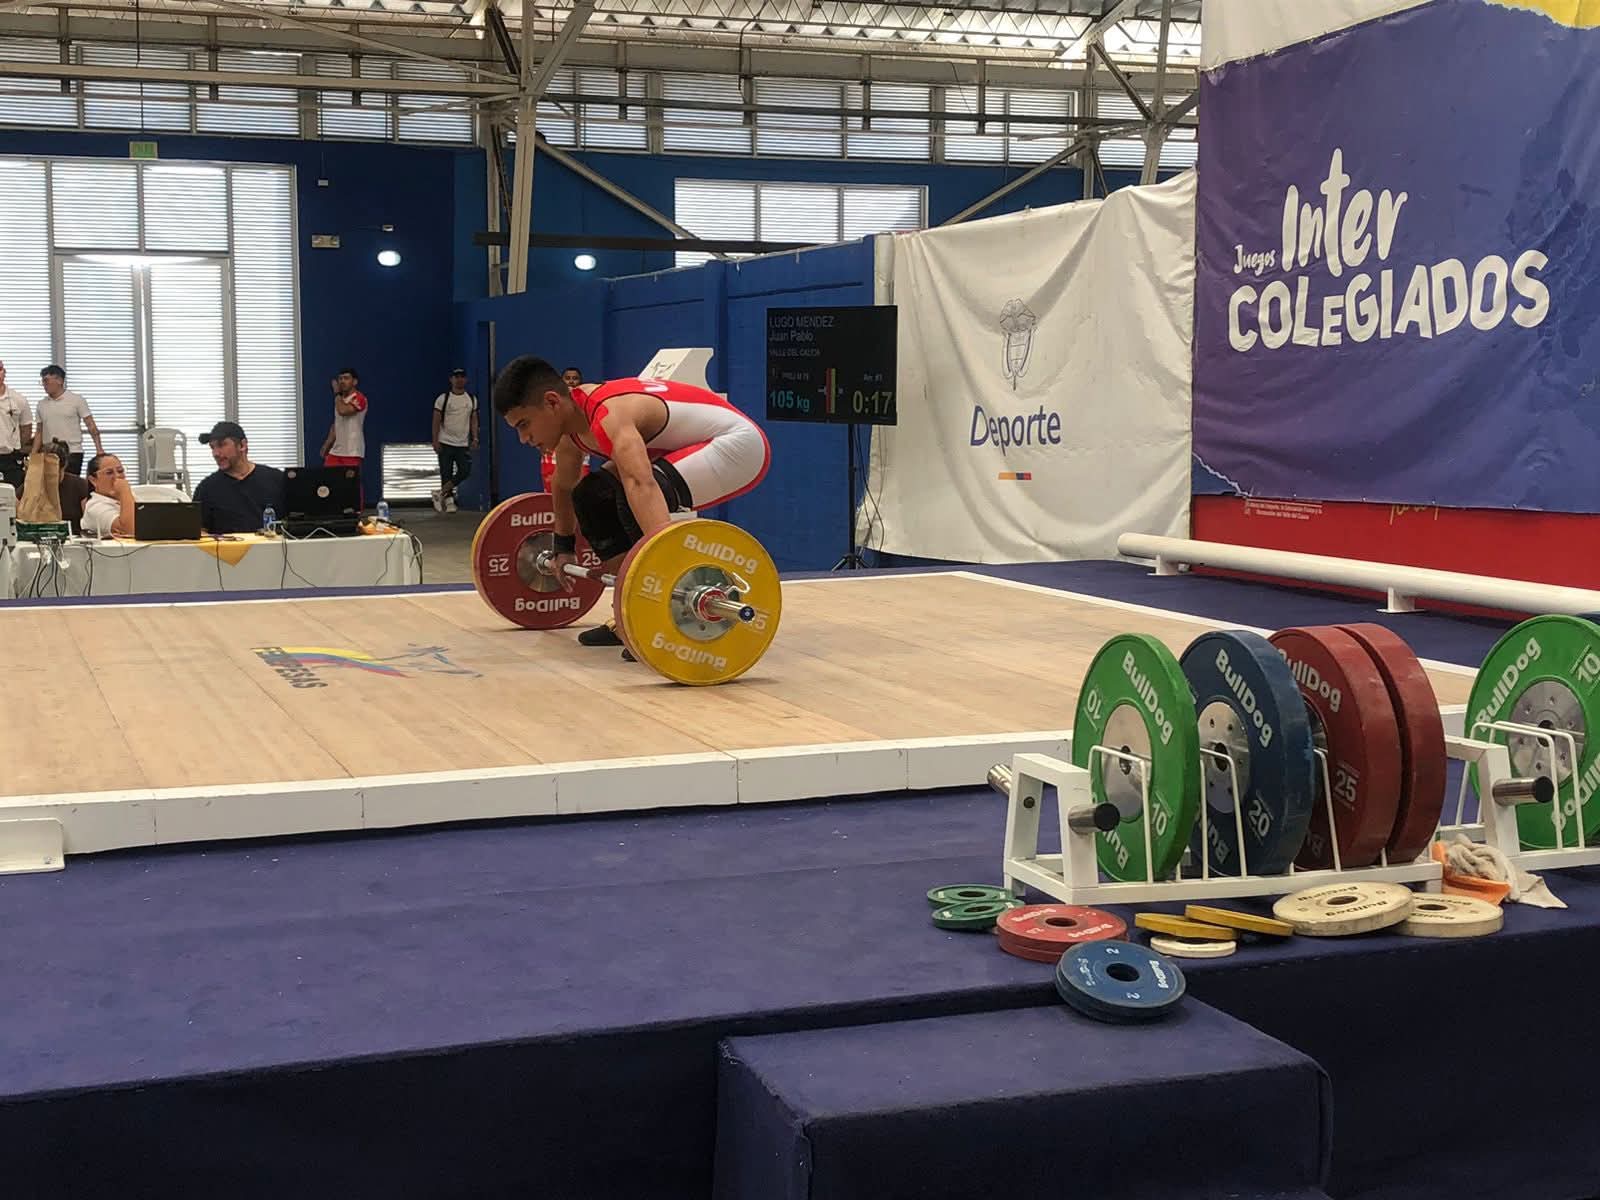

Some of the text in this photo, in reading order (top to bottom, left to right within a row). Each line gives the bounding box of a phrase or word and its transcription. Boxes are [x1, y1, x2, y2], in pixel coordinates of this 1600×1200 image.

[1233, 148, 1408, 278] Juegos Inter
[1228, 249, 1550, 353] COLEGIADOS
[769, 315, 835, 328] LUGO MENDEZ
[769, 330, 813, 342] Juan Pablo
[769, 391, 810, 412] 105 kg
[853, 390, 893, 414] 0:17
[970, 404, 1061, 456] Deporte
[510, 512, 555, 527] BullD
[488, 557, 509, 573] 25
[582, 551, 601, 566] 25
[684, 534, 759, 574] BullDog
[641, 574, 663, 595] 15
[514, 597, 581, 612] BullDog
[651, 632, 728, 671] BullDog
[1576, 652, 1600, 685] 10
[1121, 650, 1174, 745] BullDog
[1215, 649, 1273, 748] BullDog
[1475, 637, 1542, 732] BullDog
[1333, 768, 1357, 802] 25
[1151, 802, 1167, 836] 10
[1249, 799, 1271, 838] 20
